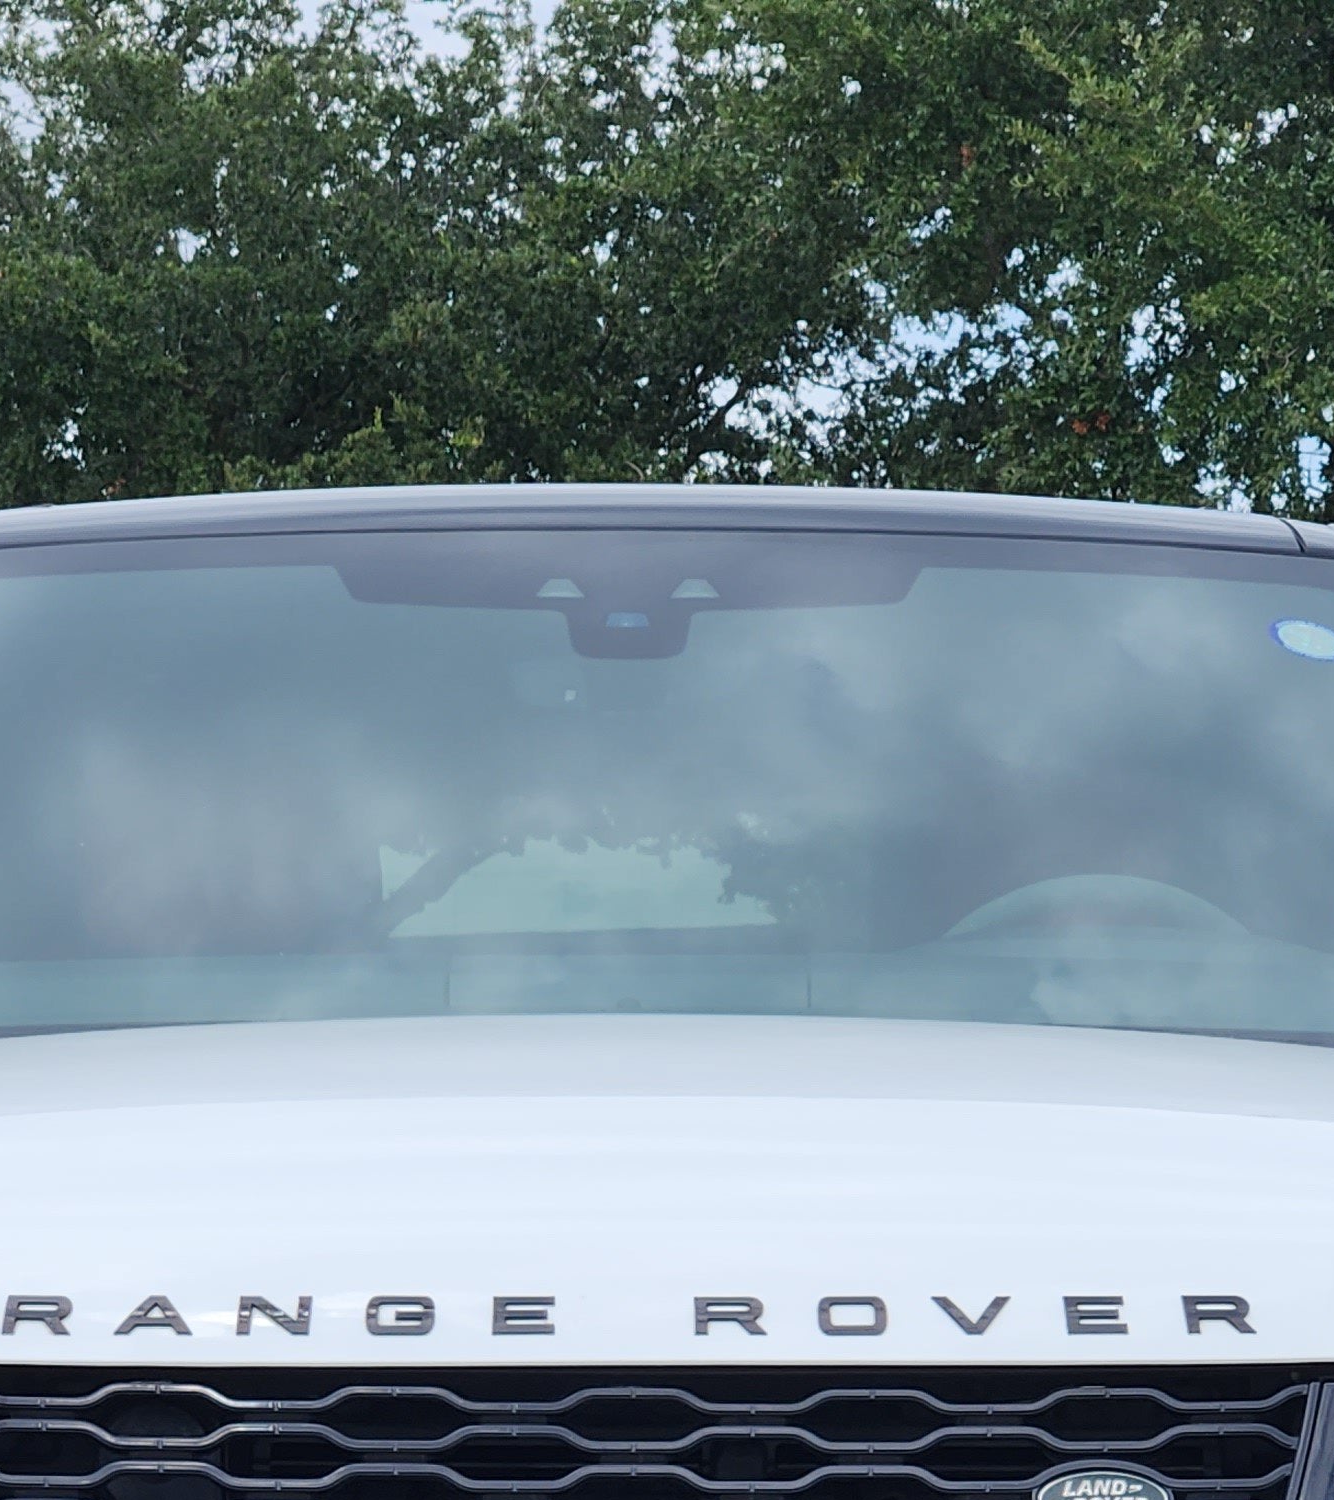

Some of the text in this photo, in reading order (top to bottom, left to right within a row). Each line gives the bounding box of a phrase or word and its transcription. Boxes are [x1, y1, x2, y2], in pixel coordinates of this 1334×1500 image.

[0, 1295, 1258, 1336] RANGE ROVER
[1062, 1479, 1127, 1498] LAND
